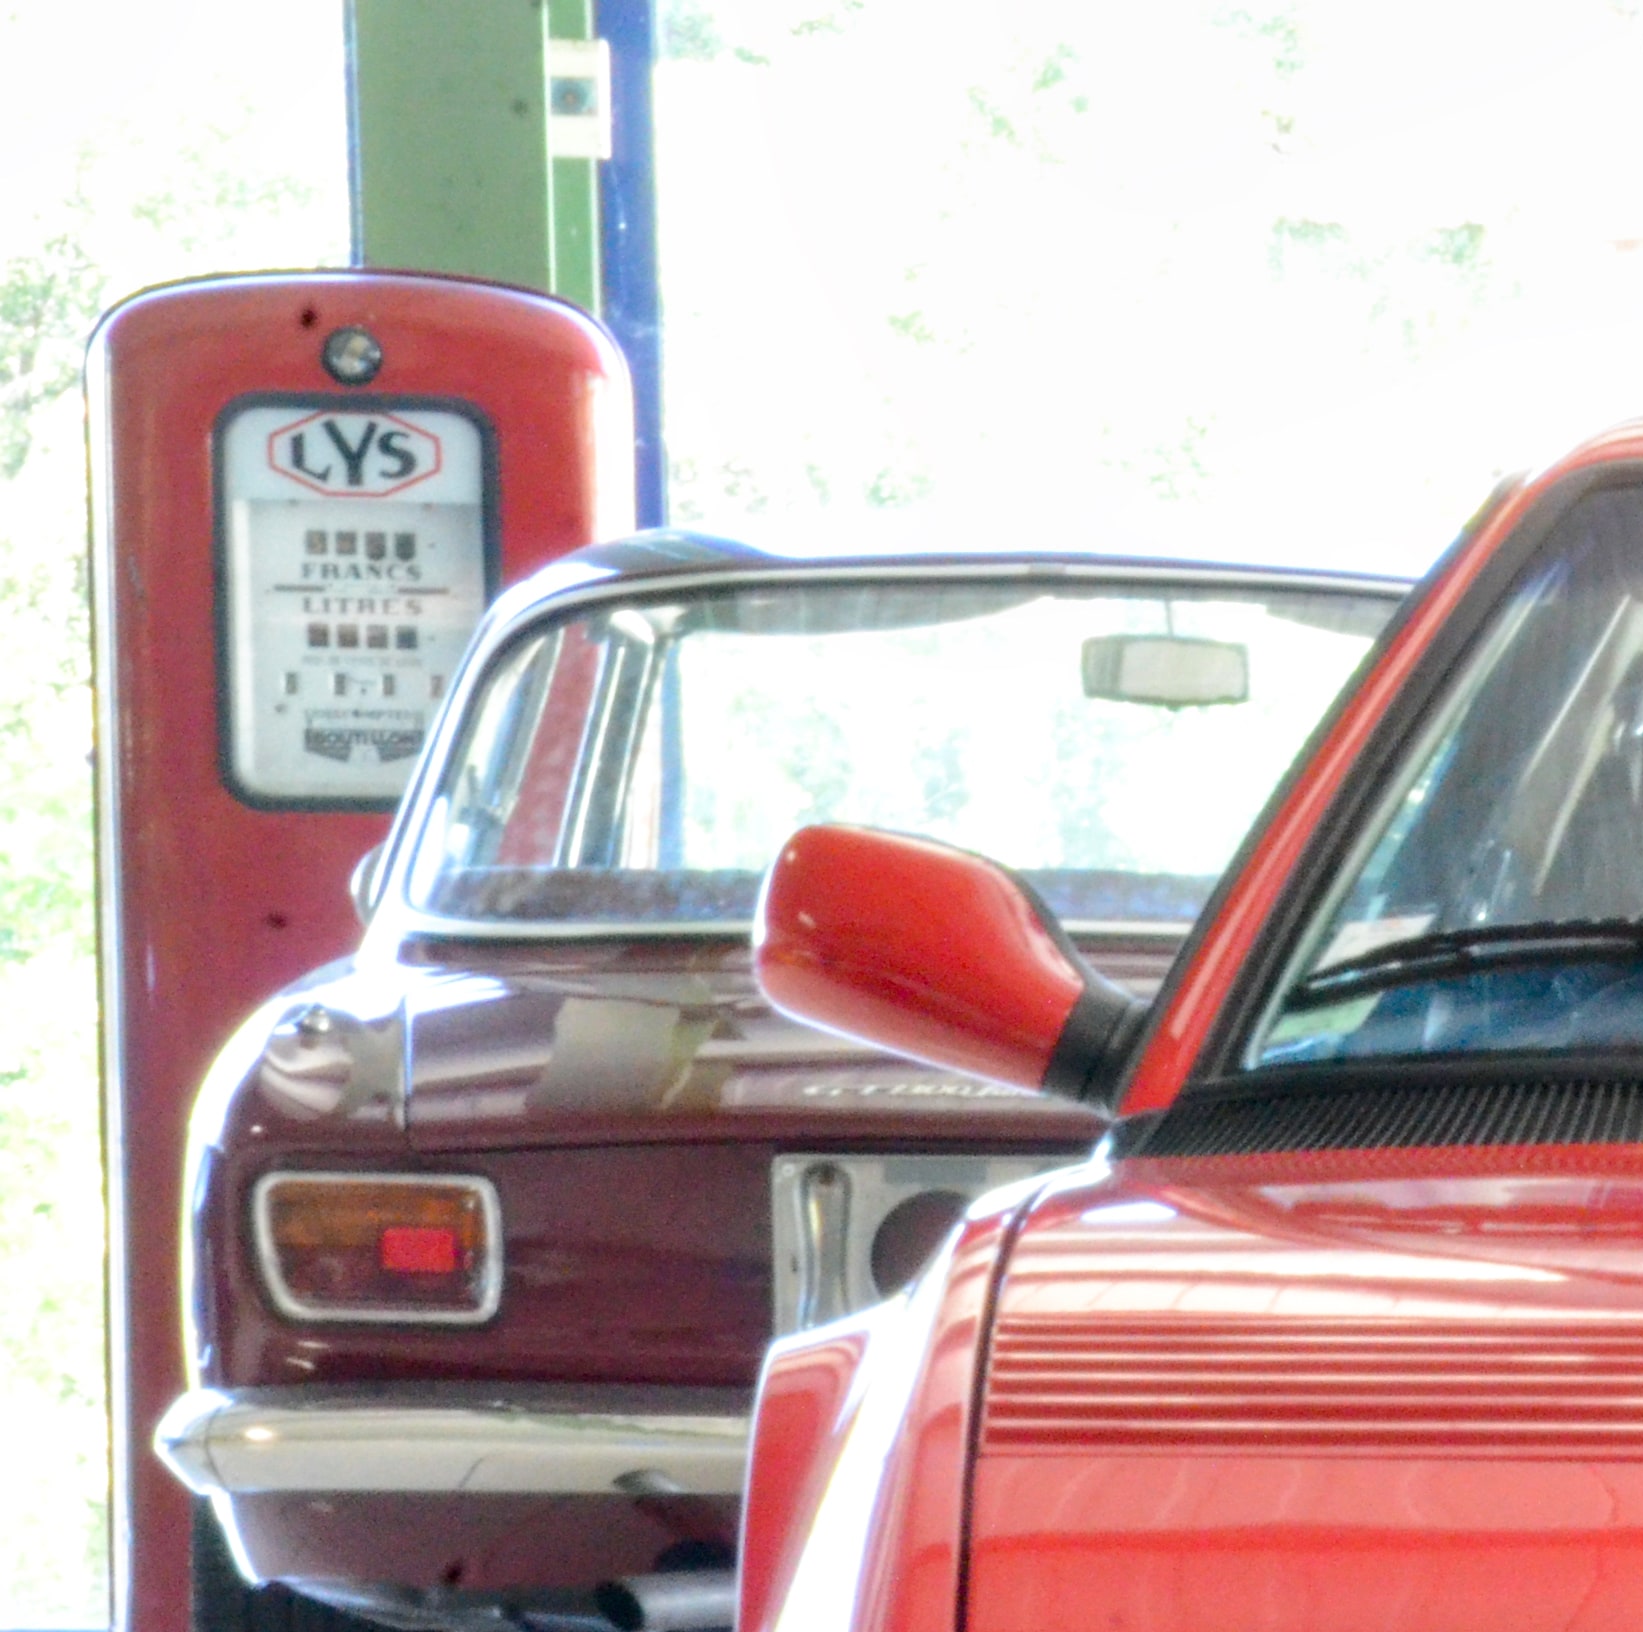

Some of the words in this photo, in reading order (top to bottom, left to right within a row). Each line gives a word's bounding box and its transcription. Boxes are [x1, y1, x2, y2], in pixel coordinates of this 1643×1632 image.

[290, 418, 418, 487] LYS
[301, 562, 423, 582] FRANCS
[302, 597, 423, 616] LITRES
